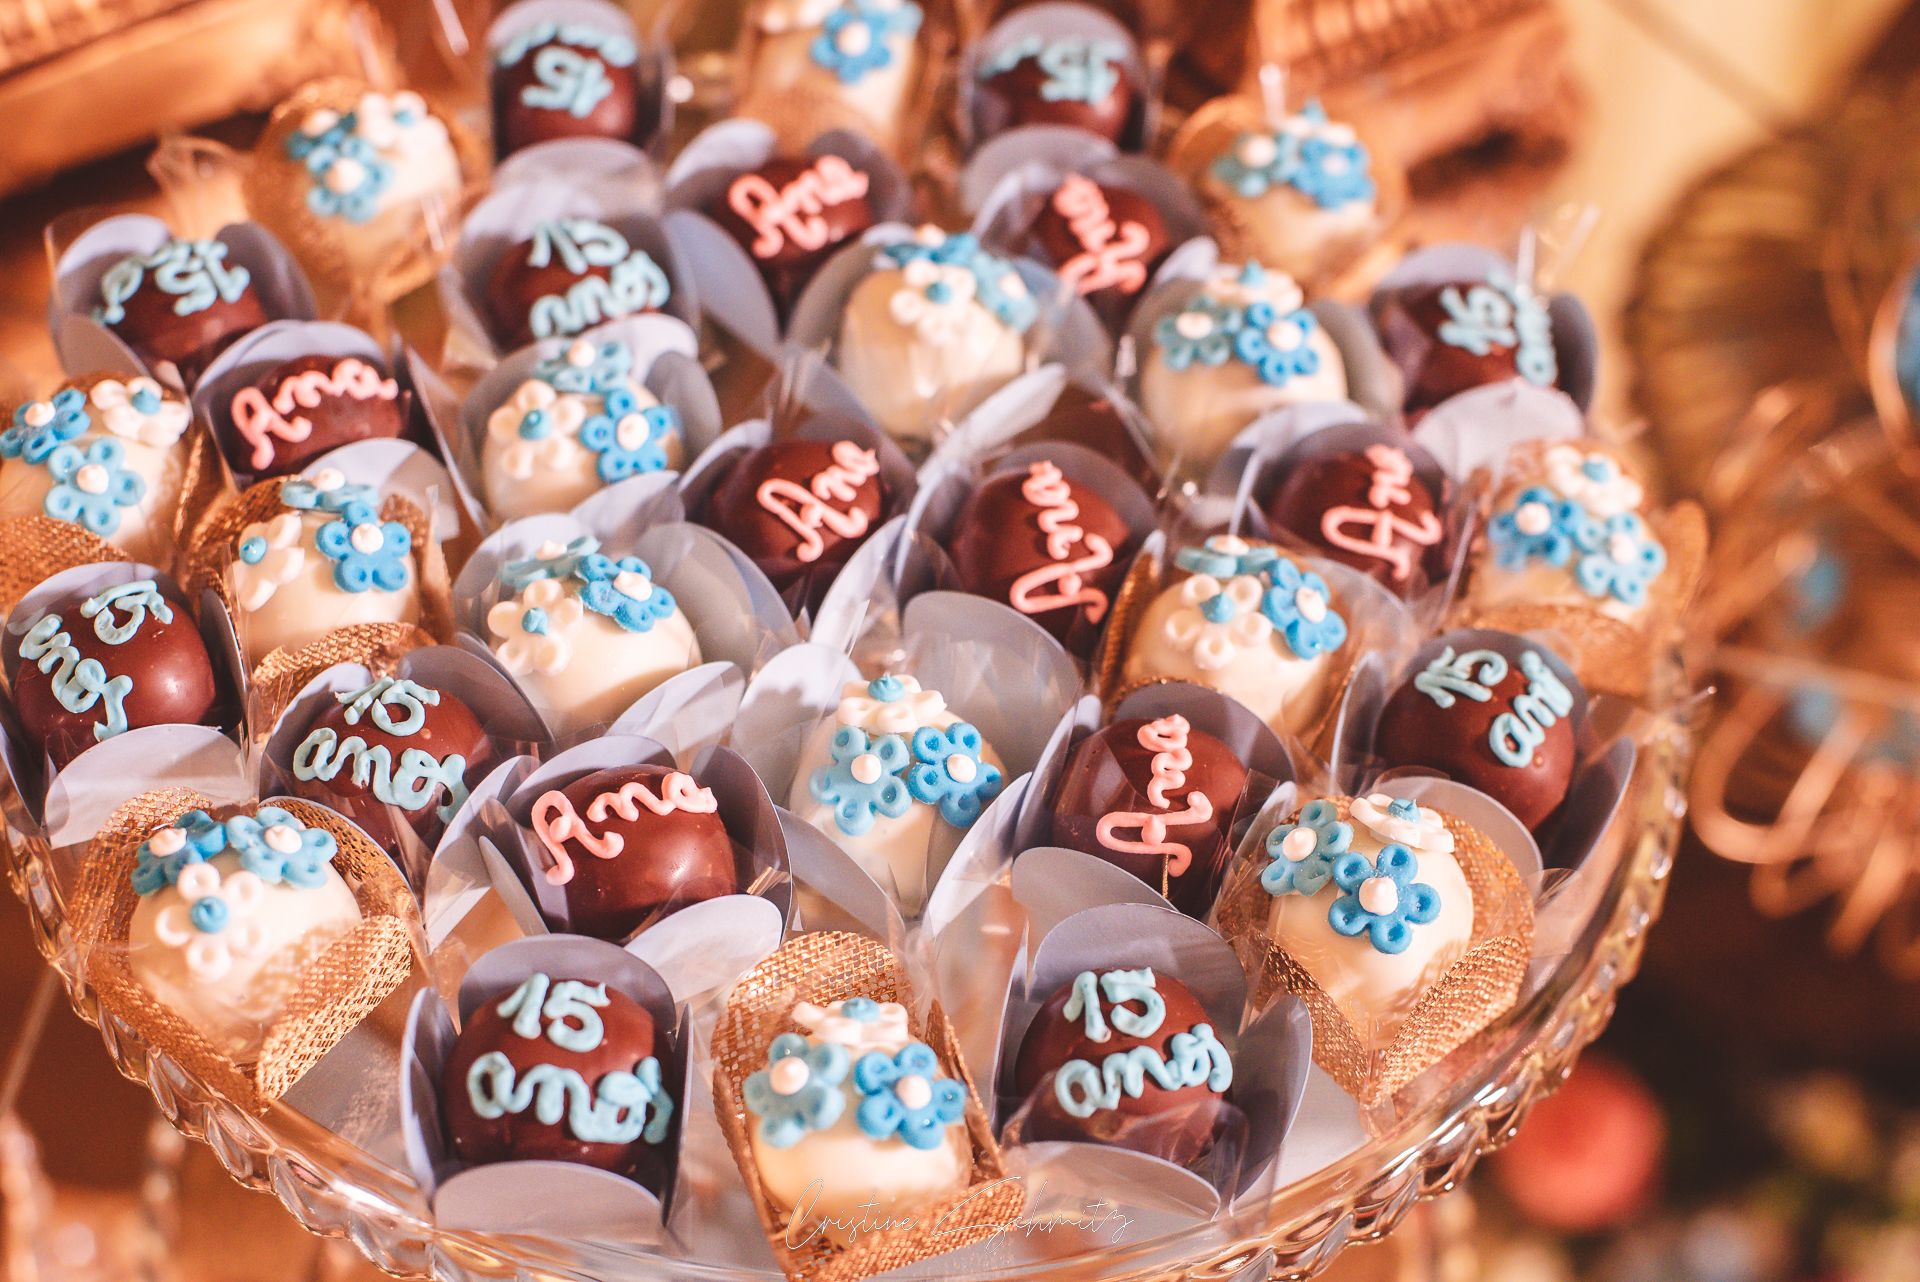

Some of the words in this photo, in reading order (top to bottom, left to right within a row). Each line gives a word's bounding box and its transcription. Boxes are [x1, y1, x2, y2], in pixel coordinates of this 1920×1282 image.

[521, 46, 614, 118] 15
[728, 154, 869, 258] Ana
[1439, 286, 1517, 357] 15
[231, 358, 399, 470] Ana
[756, 440, 880, 563] Ana
[1010, 460, 1114, 625] Ana
[335, 675, 440, 737] 15
[1414, 646, 1508, 709] 15
[531, 772, 718, 886] Ana
[1095, 714, 1214, 878] Ana
[497, 972, 611, 1053] 15
[1063, 967, 1166, 1043] 15
[466, 1051, 674, 1144] anos
[1054, 1023, 1233, 1118] anos
